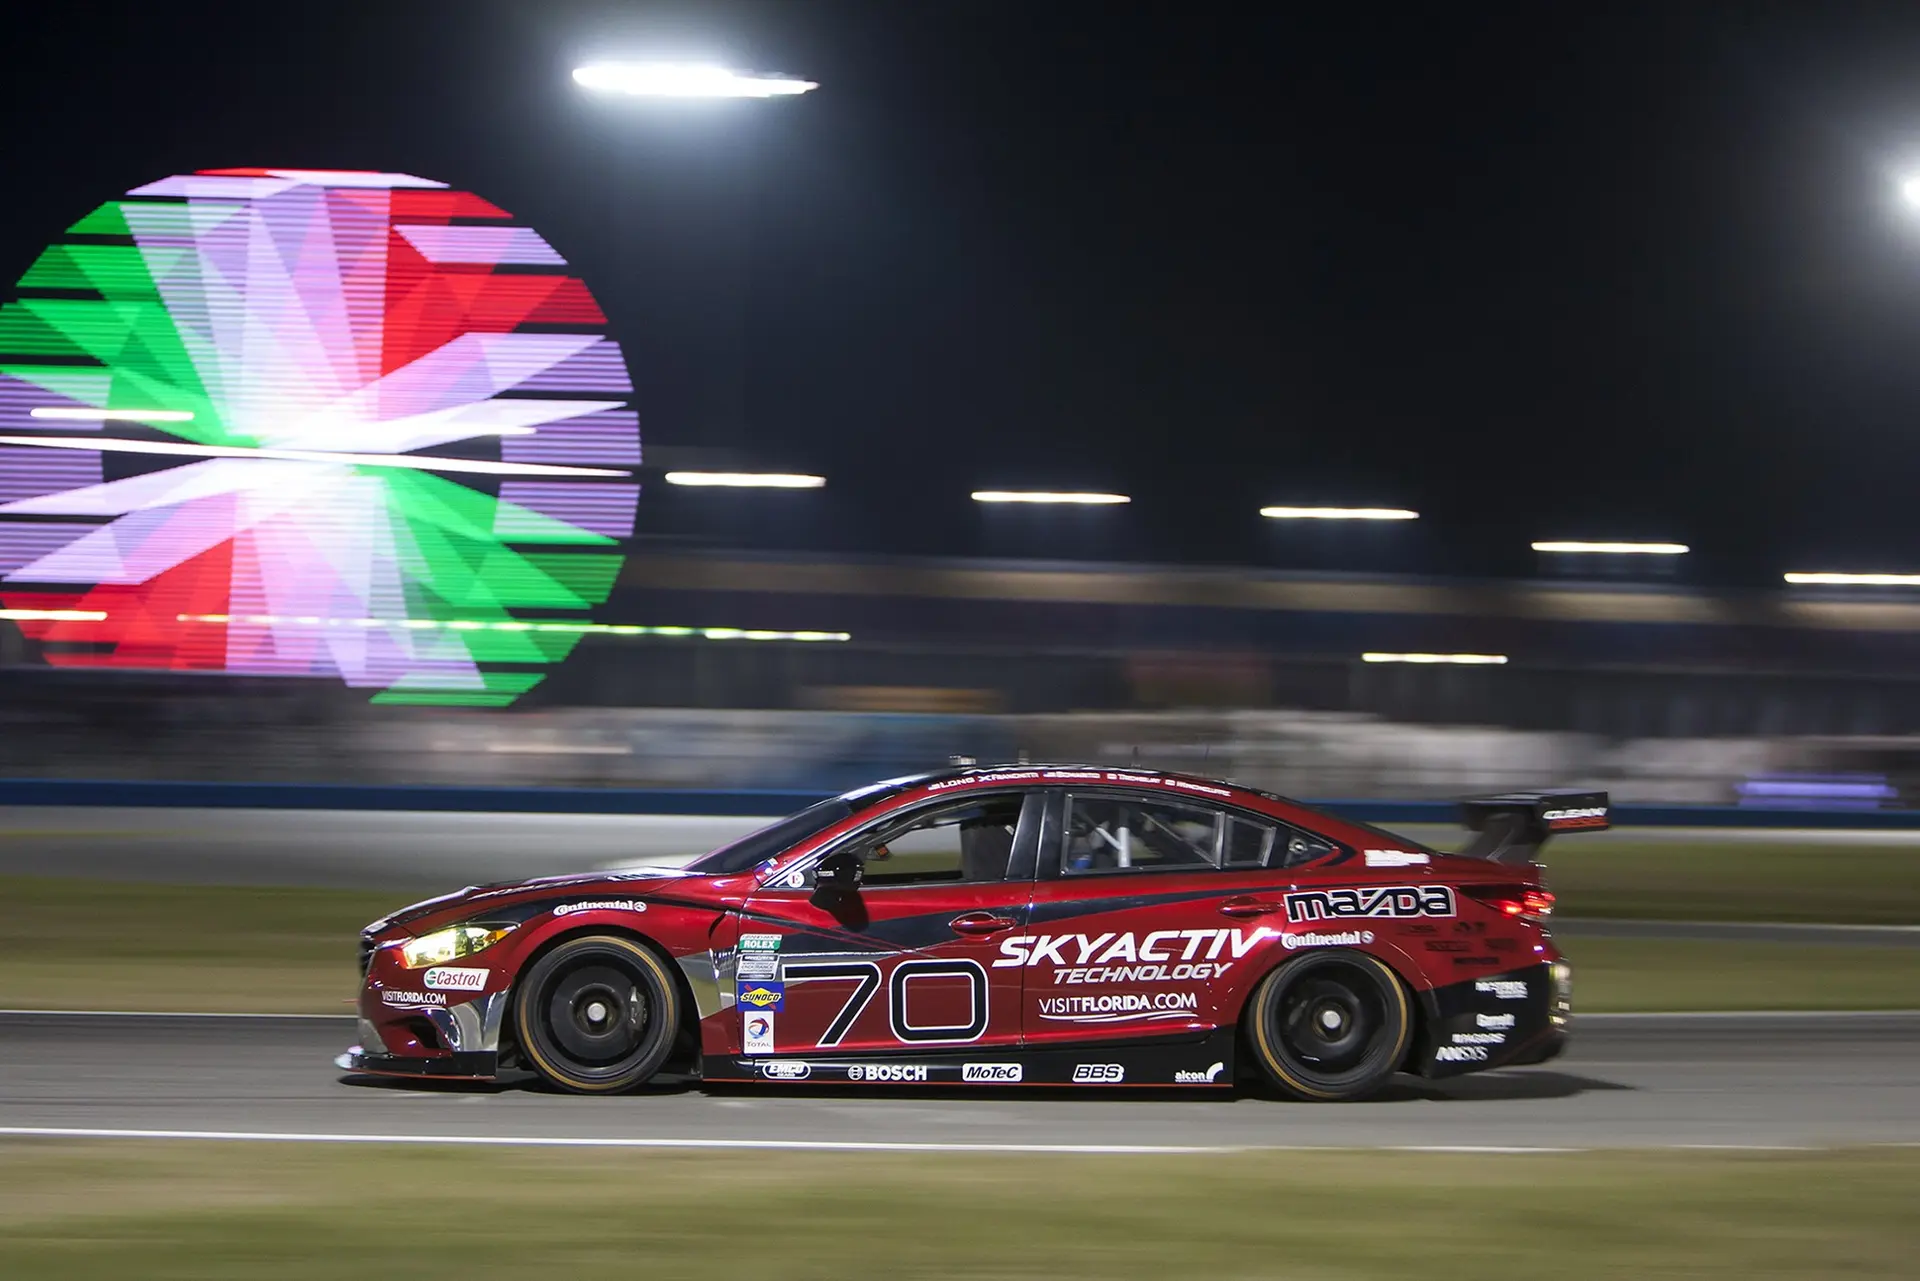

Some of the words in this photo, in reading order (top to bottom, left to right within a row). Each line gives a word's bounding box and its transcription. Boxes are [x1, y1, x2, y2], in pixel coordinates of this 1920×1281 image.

[940, 777, 975, 788] LONG
[553, 900, 634, 916] Continental
[743, 940, 776, 949] ROLEX
[992, 927, 1281, 968] SKYACTIV
[1281, 931, 1361, 950] Continental
[436, 970, 482, 986] Castrol
[1053, 962, 1235, 985] TECHNOLOGY
[381, 990, 447, 1005] VISITFLORIDA.COM
[742, 993, 781, 1001] SUNOCO
[782, 958, 989, 1047] 70
[1039, 992, 1199, 1014] VISITFLORIDA.COM
[865, 1065, 927, 1081] BOSCH
[967, 1066, 1020, 1079] MoTeC
[1076, 1066, 1122, 1080] BBS
[1174, 1069, 1206, 1080] alcon
